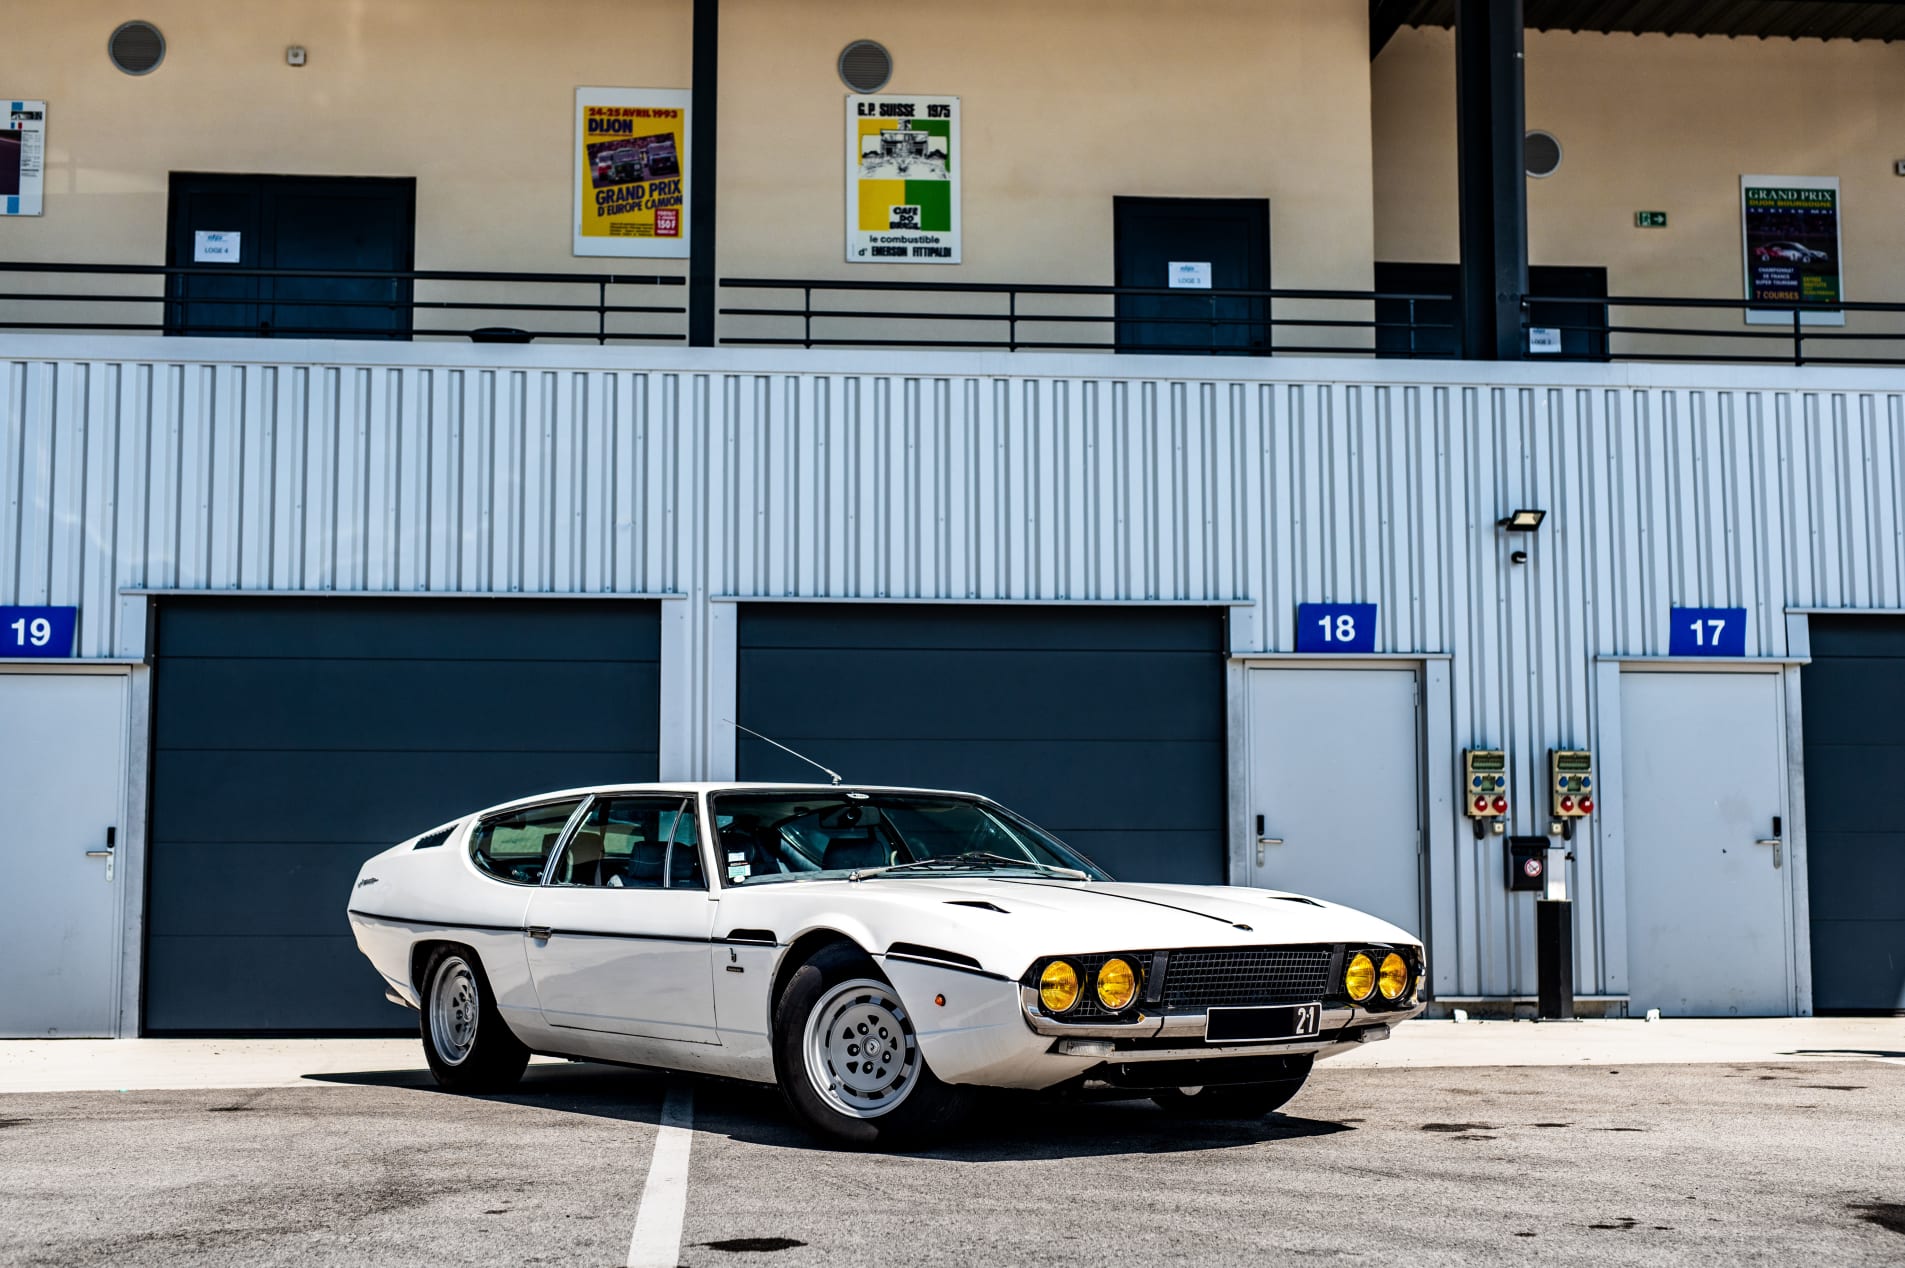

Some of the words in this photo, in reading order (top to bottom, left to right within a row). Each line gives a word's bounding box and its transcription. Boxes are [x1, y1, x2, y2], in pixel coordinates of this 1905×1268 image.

[589, 108, 620, 117] 24-25
[622, 109, 651, 118] AVRIL
[652, 110, 678, 119] 1993
[857, 103, 876, 116] G.P.
[879, 103, 915, 117] SUISSE
[927, 104, 950, 118] 1975
[588, 118, 633, 133] DIJON
[595, 185, 646, 206] GRAND
[649, 179, 681, 198] PRIX
[1748, 190, 1798, 200] GRAND
[1801, 191, 1832, 200] PRIX
[645, 195, 683, 210] CAMION
[869, 235, 878, 243] le
[880, 235, 940, 243] combustible
[871, 246, 907, 257] EMERSON
[912, 247, 952, 257] FITTIPALDI
[1763, 291, 1799, 300] COURSES
[11, 617, 51, 646] 19
[1318, 615, 1356, 642] 18
[1690, 619, 1726, 646] 17
[1296, 1006, 1315, 1034] 21
